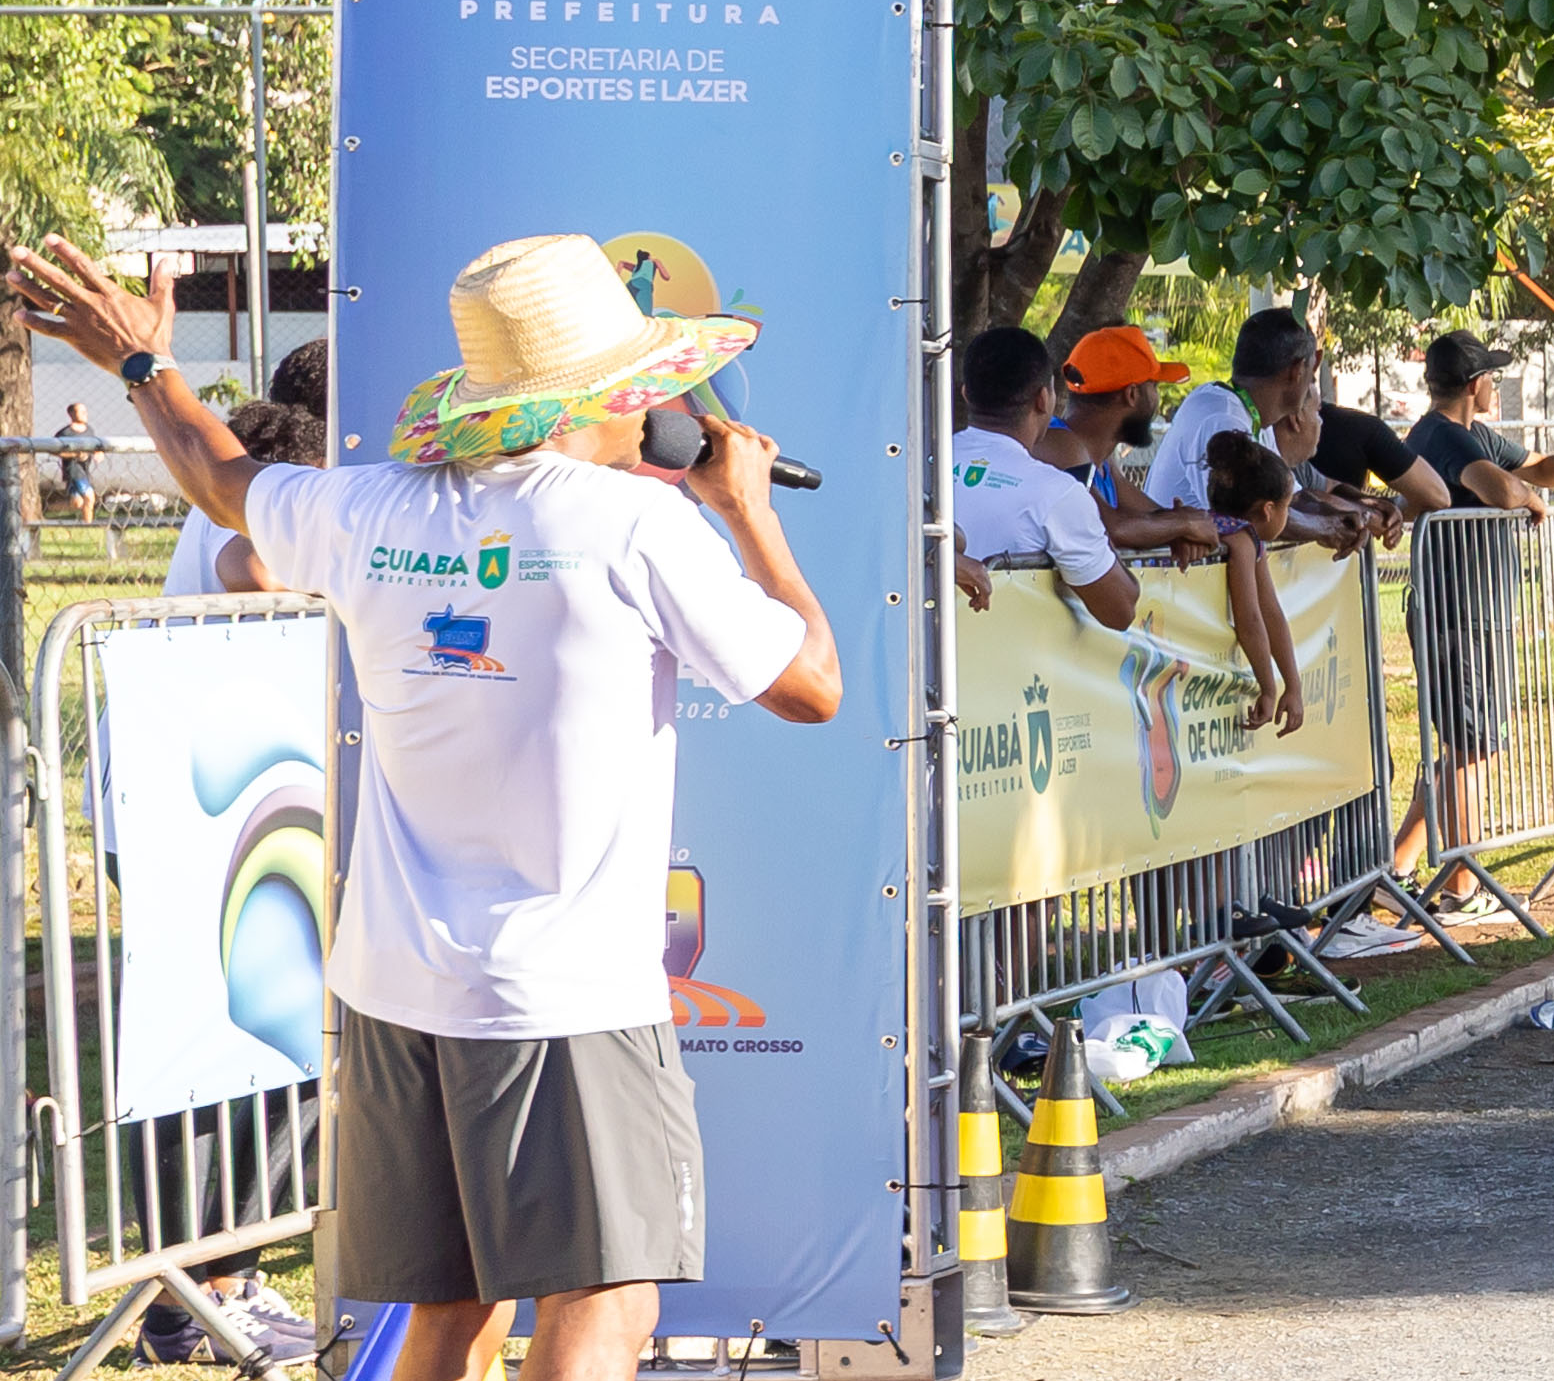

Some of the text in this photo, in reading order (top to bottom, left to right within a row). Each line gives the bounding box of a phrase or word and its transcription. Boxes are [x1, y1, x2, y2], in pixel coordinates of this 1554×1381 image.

[460, 0, 780, 25] PREFEITURA
[511, 47, 724, 73] SECRETARIA DE
[486, 75, 748, 103] ESPORTES E LAZER
[369, 546, 470, 576] CUIABÁ
[518, 571, 550, 582] LAZER
[1182, 672, 1225, 712] BOM
[1188, 721, 1207, 763] DE
[957, 775, 1024, 802] REFEITURA
[681, 1039, 804, 1053] MATO GROSSO
